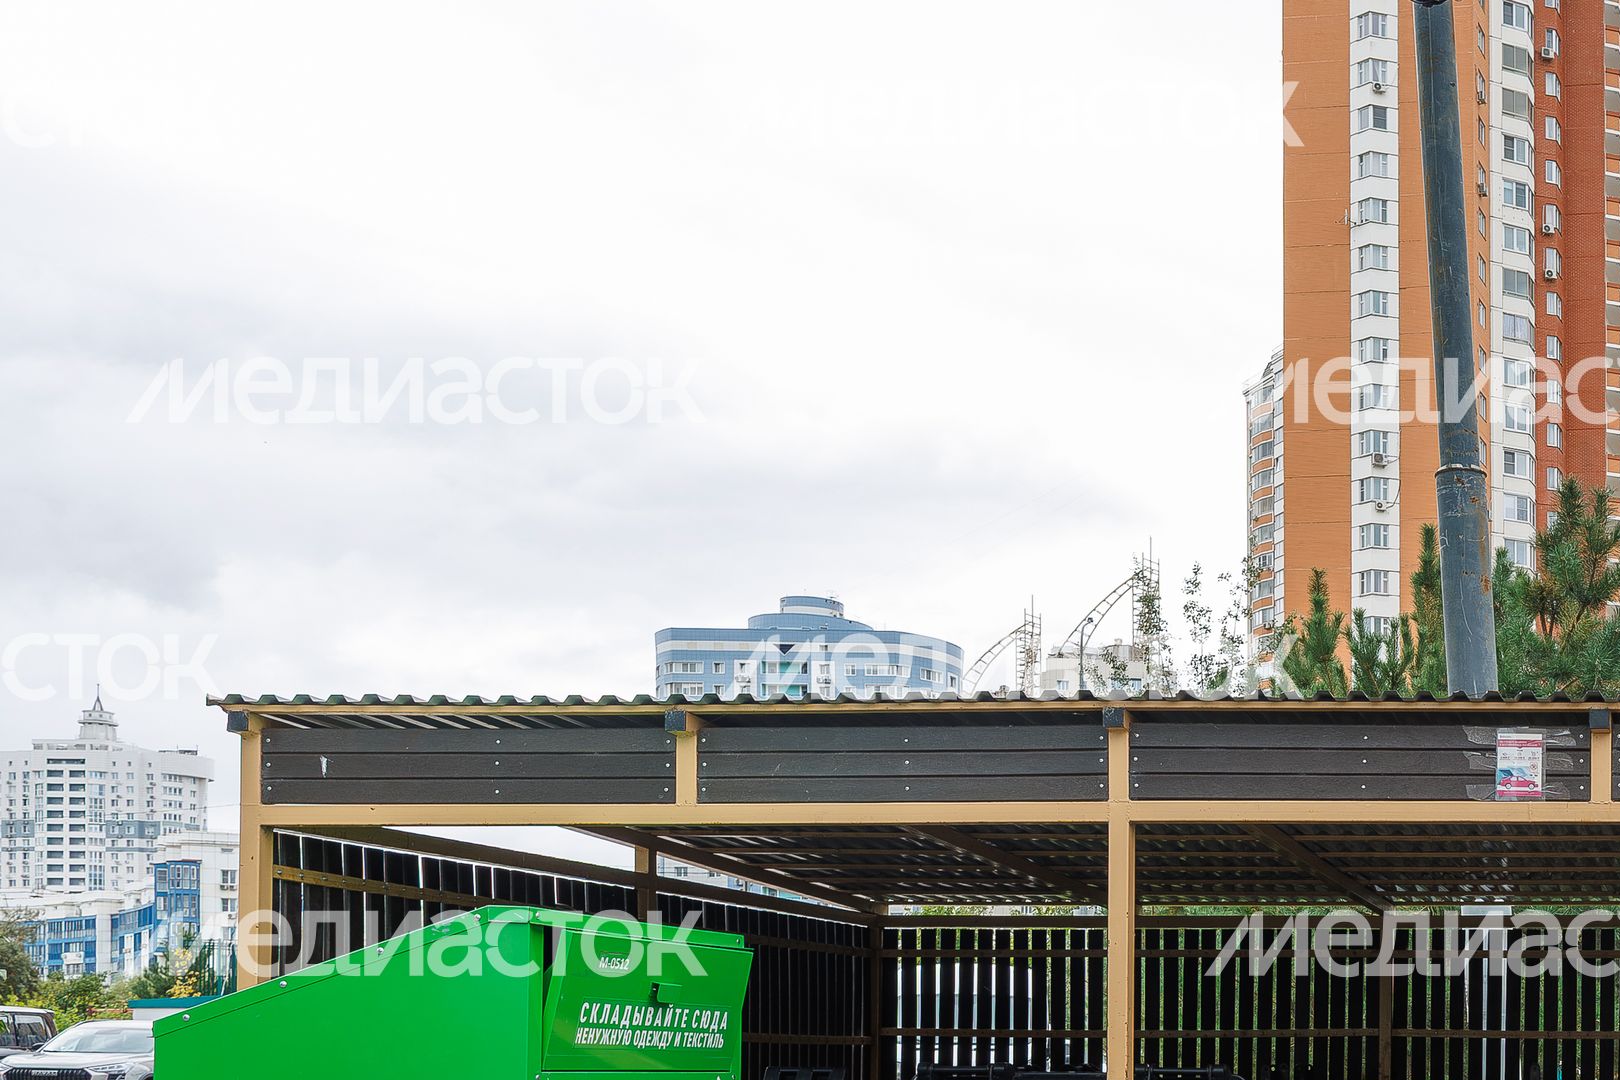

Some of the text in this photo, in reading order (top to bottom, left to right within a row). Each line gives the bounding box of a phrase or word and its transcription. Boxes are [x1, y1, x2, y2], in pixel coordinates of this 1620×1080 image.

[579, 1002, 728, 1032] СКЛАДЫВАЙТЕ СЮДА
[575, 1027, 724, 1049] НЕНУЖНУЮ ОДЕЖДУ И ТЕКСТИЛЬ
